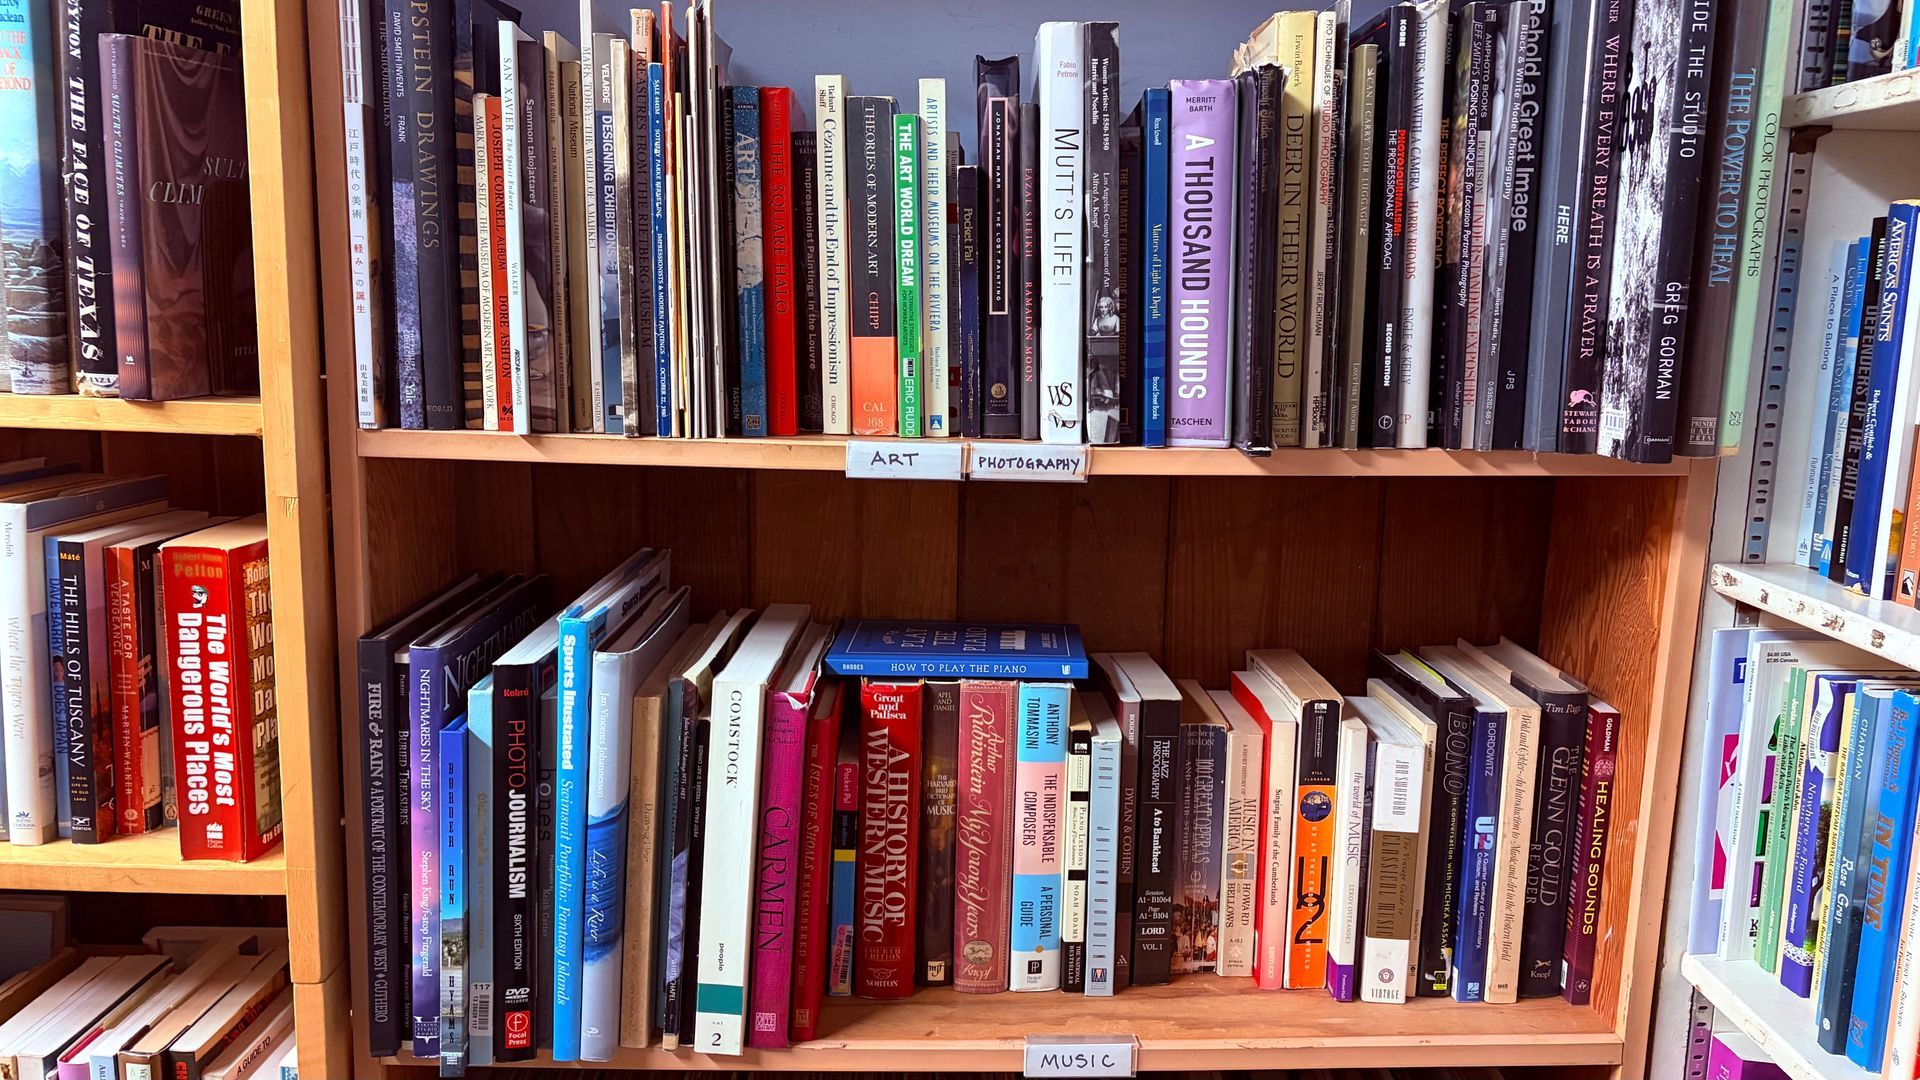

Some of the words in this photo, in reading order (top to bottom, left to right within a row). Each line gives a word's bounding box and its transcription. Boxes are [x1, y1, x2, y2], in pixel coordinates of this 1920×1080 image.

[393, 12, 402, 34] DAVID
[394, 37, 403, 61] SMITH
[410, 1, 432, 95] PSTEIN
[1601, 34, 1620, 103] WHERE
[1688, 46, 1704, 78] THE
[395, 64, 405, 97] INVENTS
[503, 58, 512, 84] SAN
[601, 64, 610, 103] VELARDE
[1521, 83, 1536, 95] a
[1728, 68, 1757, 113] THE
[70, 77, 85, 132] THE
[504, 88, 514, 131] XAVIER
[568, 81, 579, 116] National
[398, 115, 406, 142] FRANK
[526, 99, 535, 143] Sammon
[569, 119, 579, 158] Museum
[865, 105, 876, 170] THEORIES
[899, 123, 913, 151] THE
[1185, 134, 1215, 151] A
[1388, 129, 1397, 145] THE
[1517, 101, 1539, 160] Great
[1595, 111, 1613, 167] EVERY
[1680, 92, 1701, 158] STUDIO
[1762, 113, 1777, 163] COLOR
[493, 125, 503, 172] JOSEPH
[602, 115, 615, 181] DESIGNING
[823, 118, 838, 181] Cézanne
[1285, 114, 1305, 173] DEER
[1720, 120, 1751, 195] POWER
[72, 139, 88, 204] FACE
[348, 128, 363, 220] 江戸時代の美術
[416, 111, 439, 249] DRAWINGS
[526, 146, 537, 203] takojattaret
[866, 173, 876, 190] OF
[900, 154, 914, 182] ART
[1025, 168, 1033, 207] FAZAL
[1053, 129, 1080, 220] MUTT'S
[1384, 148, 1397, 220] PROFESSIONALS'
[494, 175, 504, 231] CORNELL
[824, 184, 837, 209] and
[900, 186, 914, 237] WORLD
[1284, 182, 1303, 206] IN
[1512, 168, 1533, 232] Image
[1589, 175, 1609, 247] BREATH
[1715, 199, 1742, 228] TO
[76, 214, 93, 247] OF
[605, 185, 617, 257] EXHIBITIONS
[825, 213, 838, 234] the
[866, 194, 877, 247] MODERN
[1025, 211, 1033, 258] SHEIKH
[1151, 224, 1162, 251] Matters
[1182, 156, 1214, 291] THOUSAND
[1555, 205, 1570, 246] HERE.
[1748, 169, 1770, 276] PHOTOGRAPHS
[497, 236, 506, 270] ALBUM
[826, 237, 840, 265] End
[868, 251, 878, 276] ART
[901, 240, 915, 286] DREAM
[1151, 254, 1162, 262] of
[1281, 214, 1301, 285] THEIR
[1383, 222, 1394, 269] APPROACH
[1587, 255, 1601, 269] IS
[1709, 234, 1737, 287] HEAL
[1874, 238, 1886, 280] HEILMAN
[1884, 218, 1907, 289] AMERICA'S
[354, 235, 367, 314] 「軽み」の誕生
[826, 268, 840, 283] of
[1151, 264, 1162, 284] Light
[1587, 271, 1600, 285] A
[77, 256, 100, 361] TEXAS
[499, 295, 509, 327] DORE
[868, 292, 879, 329] CHIPP
[1025, 282, 1033, 340] RAMADAN
[1150, 296, 1161, 318] Depth
[1663, 282, 1681, 324] GREG
[1878, 292, 1898, 341] SAINTS
[825, 287, 842, 384] Impressionism
[1277, 295, 1297, 378] WORLD
[1384, 323, 1393, 354] SECOND
[1580, 293, 1597, 359] PRAYER
[500, 333, 511, 378] ASHTON
[1178, 299, 1210, 399] HOUNDS
[1383, 356, 1392, 386] EDITION
[1656, 336, 1677, 399] GORMAN
[904, 379, 914, 402] ERIC
[1506, 370, 1515, 389] JPS
[863, 403, 887, 411] CAL
[868, 418, 883, 427] 168
[905, 405, 915, 436] RUDD
[871, 451, 919, 467] ART
[979, 456, 1080, 475] PHOTOGRAPHY
[64, 575, 78, 606] THE
[174, 566, 224, 578] Pelton
[65, 613, 80, 654] HILLS
[207, 614, 226, 654] The
[68, 660, 81, 680] OF
[177, 612, 205, 734] Dangerous
[560, 635, 576, 686] Sports
[891, 664, 916, 673] HOW
[921, 664, 935, 672] TO
[939, 664, 965, 673] PLAY
[970, 664, 990, 673] THE
[993, 665, 1027, 673] PIANO
[209, 661, 230, 745] World's
[419, 669, 431, 746] NIGHTMARES
[1026, 698, 1041, 749] TOMMASINI
[1046, 704, 1059, 746] ANTHONY
[69, 688, 85, 767] TUSCANY
[562, 690, 576, 769] Illustrated
[726, 690, 743, 786] COMSTOCK
[1162, 740, 1170, 758] THE
[1603, 718, 1613, 751] GOLDMAN
[1854, 719, 1869, 779] CHAPMAN
[420, 749, 431, 762] IN
[890, 746, 909, 763] A
[1152, 741, 1162, 799] DISCOGRAPHY
[1161, 760, 1169, 778] JAZZ
[1444, 713, 1471, 796] BONO
[187, 742, 209, 815] Places
[214, 751, 234, 806] Most
[421, 765, 431, 789] THE
[863, 727, 889, 859] WESTERN
[1044, 774, 1057, 791] THE
[1547, 746, 1570, 824] GLENN
[421, 791, 431, 812] SKY
[508, 720, 527, 898] PHOTOJOURNALISM
[1023, 791, 1037, 846] COMPOSERS
[1590, 781, 1607, 858] HEALING
[886, 772, 908, 886] HISTORY
[1042, 794, 1057, 863] INDISPENSABLE
[1876, 815, 1894, 845] IN
[757, 807, 790, 953] CARMEN
[1526, 843, 1541, 904] READER
[1539, 830, 1561, 906] GOULD
[1839, 857, 1854, 888] Rose
[863, 864, 883, 942] MUSIC
[884, 892, 904, 926] OF
[1020, 901, 1033, 927] GUIDE
[1583, 864, 1598, 934] SOUNDS
[1834, 893, 1848, 924] Gray
[1864, 855, 1891, 932] TUNE
[513, 914, 521, 937] SIXTH
[1039, 894, 1052, 940] PERSONAL
[514, 939, 522, 969] EDITION
[712, 1033, 722, 1046] 2
[1041, 1054, 1115, 1069] MUSIC
